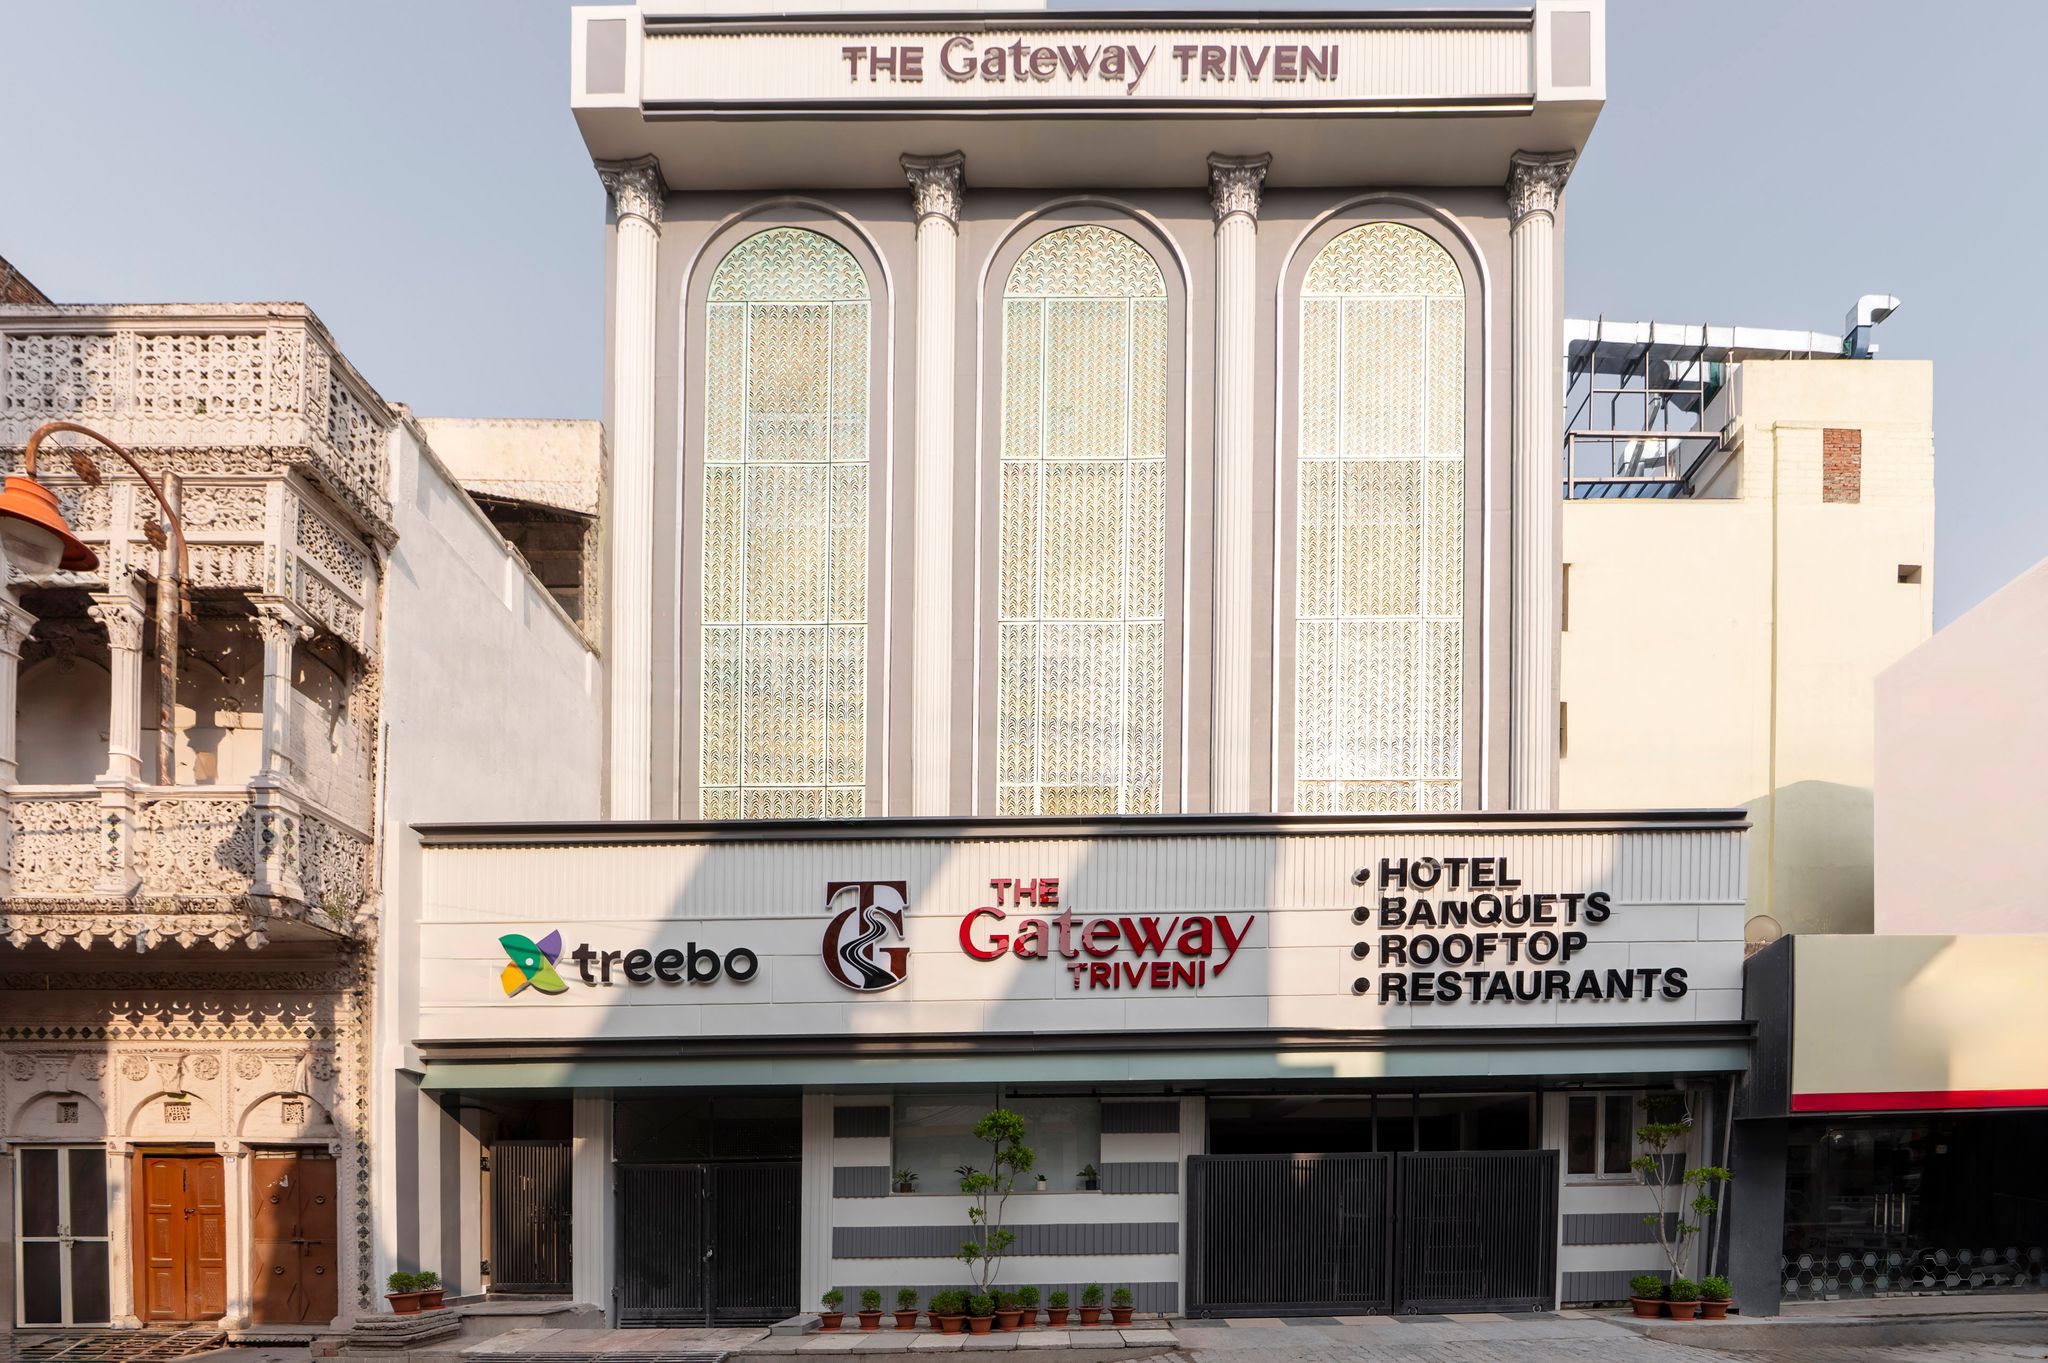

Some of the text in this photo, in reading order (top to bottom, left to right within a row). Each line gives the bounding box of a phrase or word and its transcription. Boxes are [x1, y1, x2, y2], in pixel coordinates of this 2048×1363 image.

[842, 36, 1339, 96] THE Gateway TRIVENI
[1378, 857, 1522, 889] HOTEL
[990, 877, 1060, 907] THE
[1378, 891, 1612, 929] BANQUETS
[958, 905, 1256, 978] Gateway
[1378, 931, 1589, 967] ROOFTOP
[571, 941, 760, 987] treebo
[1067, 960, 1206, 990] TRIVENI
[1378, 967, 1689, 1004] RESTAURANTS
